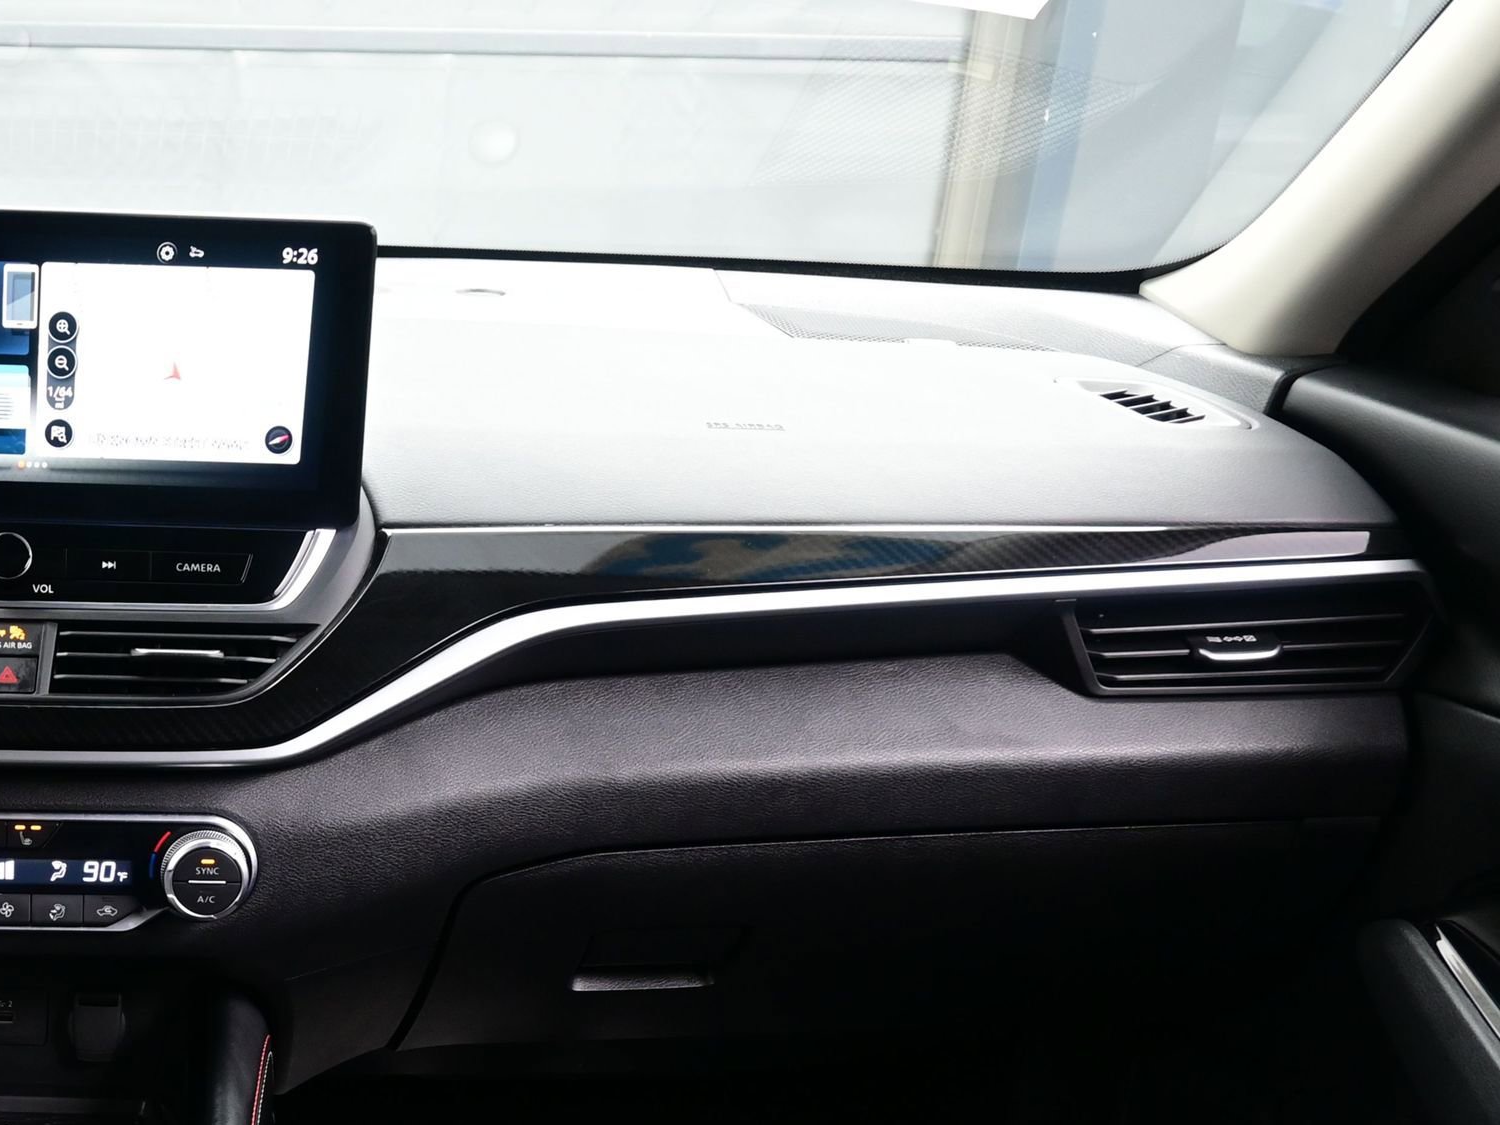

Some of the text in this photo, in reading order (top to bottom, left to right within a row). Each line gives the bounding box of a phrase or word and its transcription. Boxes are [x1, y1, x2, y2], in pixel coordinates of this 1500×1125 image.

[282, 248, 318, 264] 9:26
[47, 386, 73, 399] 1/64
[176, 562, 221, 573] CAMERA
[32, 584, 55, 594] VOL
[3, 641, 16, 649] AIR
[17, 642, 33, 650] BAG
[195, 867, 220, 876] SYNC
[196, 895, 216, 904] A/C
